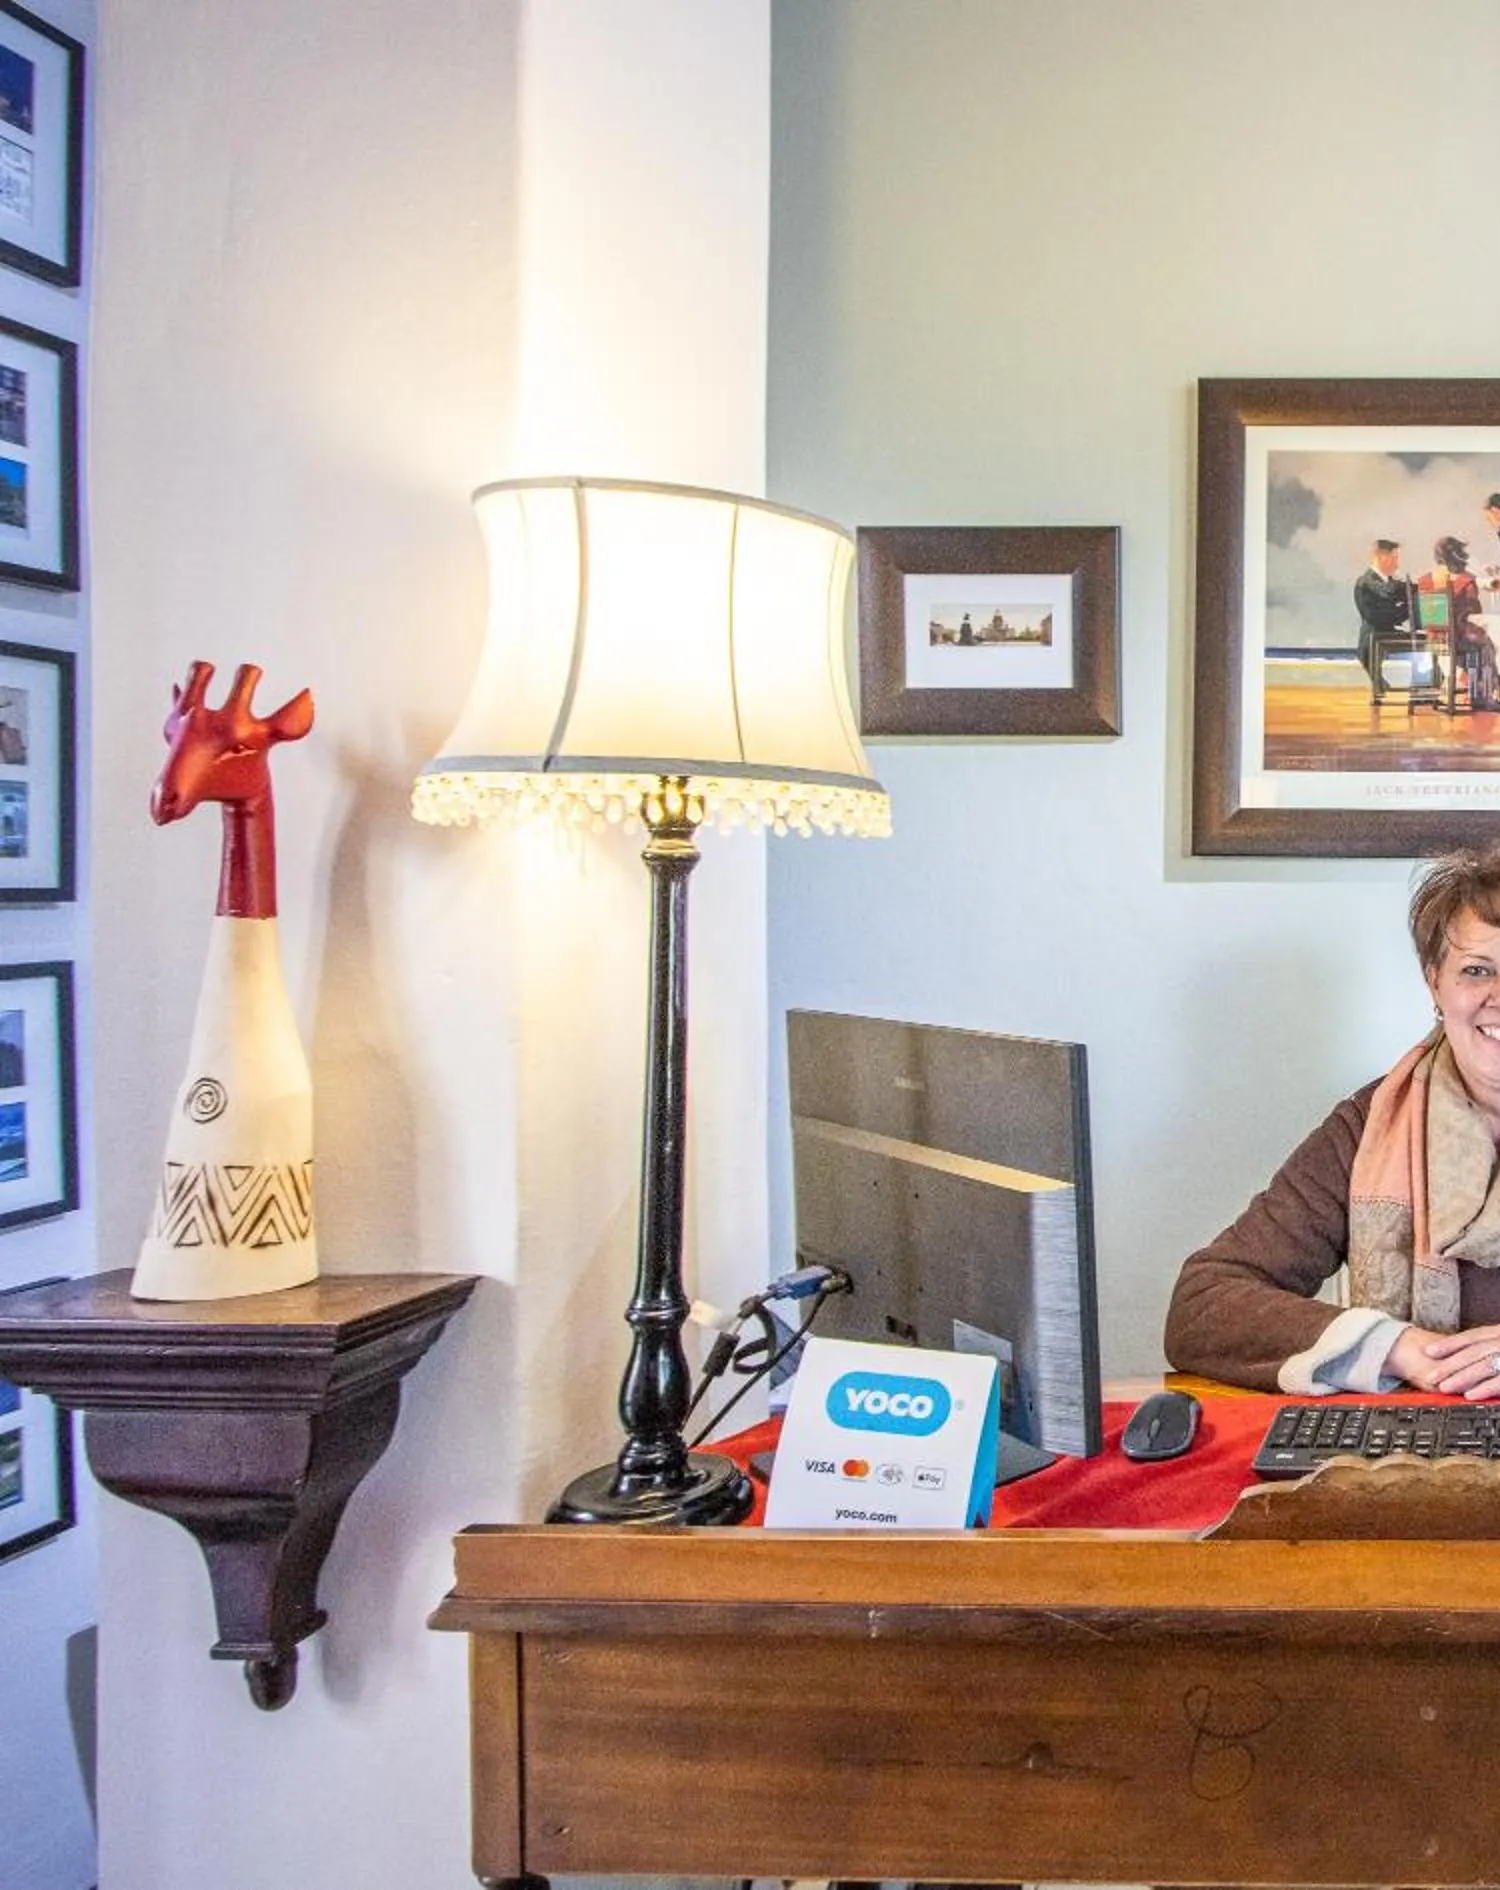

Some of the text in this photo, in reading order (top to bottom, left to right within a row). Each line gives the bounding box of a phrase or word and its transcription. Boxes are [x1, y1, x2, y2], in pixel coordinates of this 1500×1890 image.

[844, 1387, 935, 1420] YOCO
[804, 1458, 836, 1475] VISA
[834, 1507, 898, 1524] yoco.com
